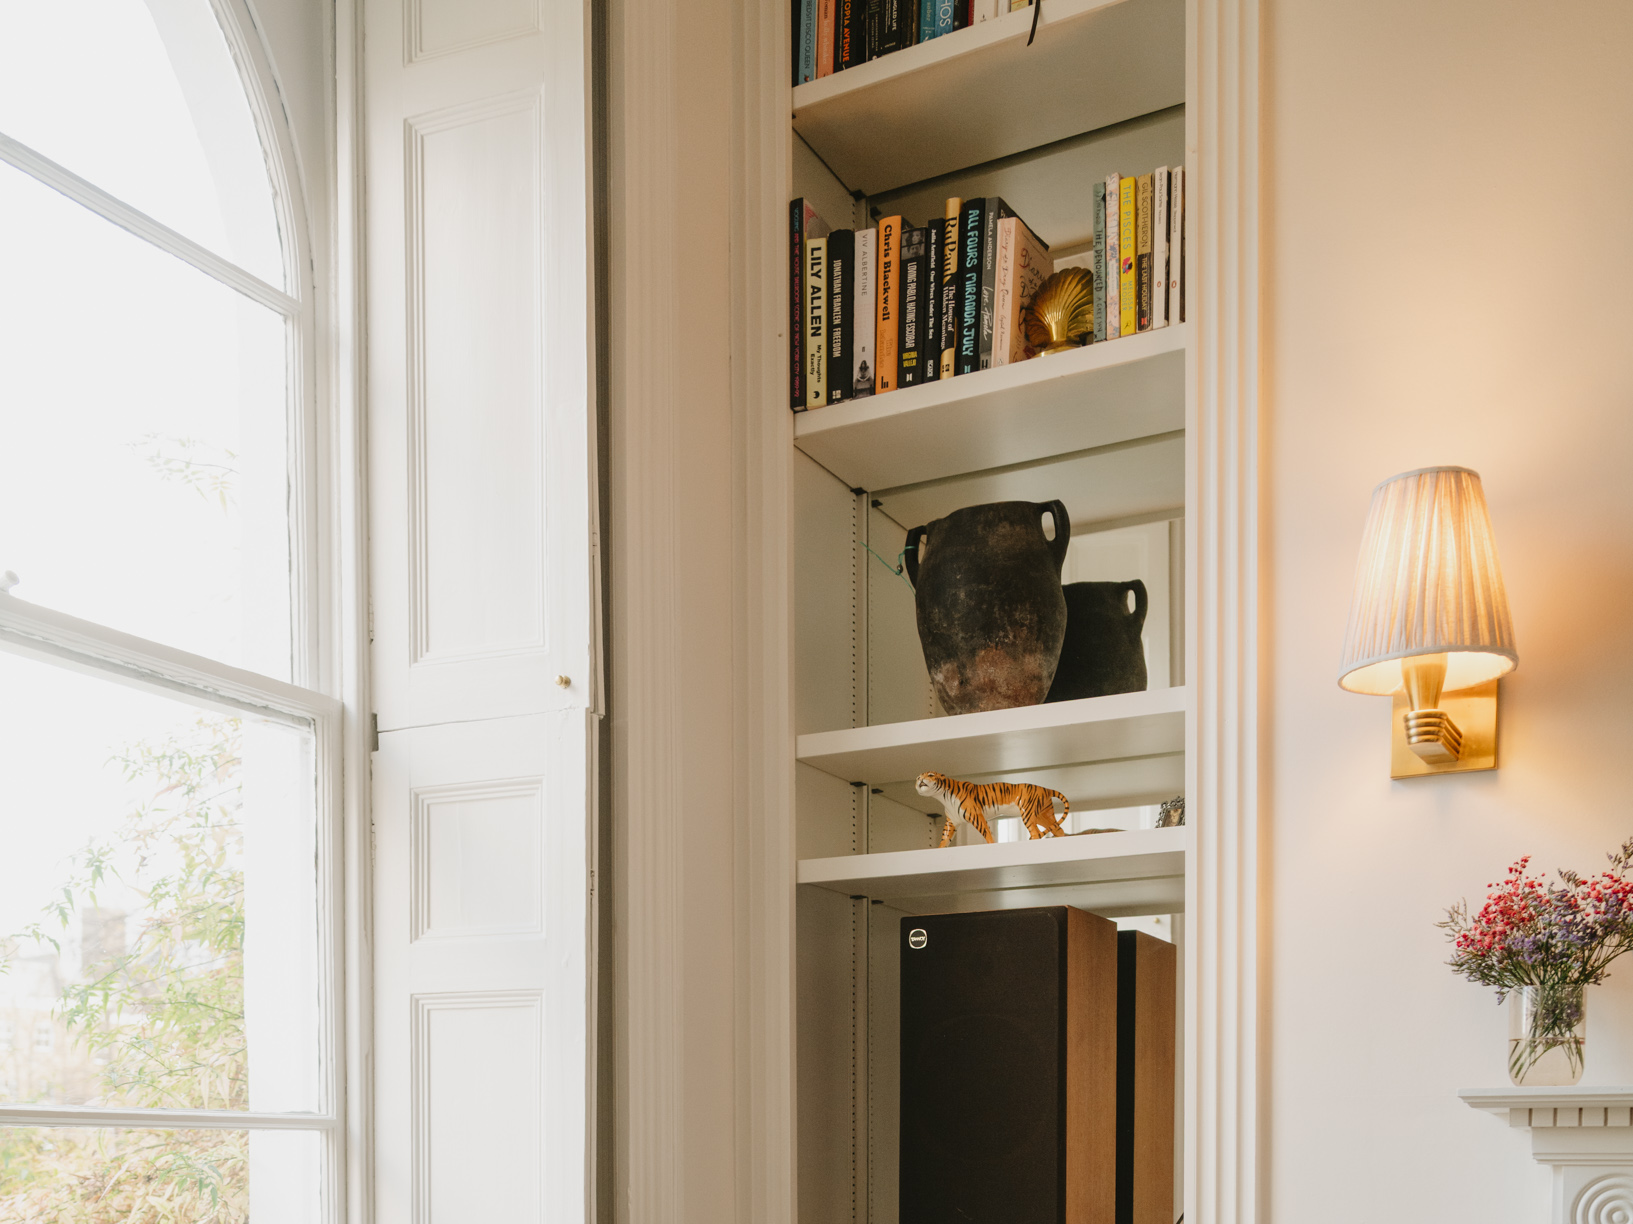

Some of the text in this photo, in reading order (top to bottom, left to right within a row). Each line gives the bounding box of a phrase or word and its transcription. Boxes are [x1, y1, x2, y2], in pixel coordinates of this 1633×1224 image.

[842, 28, 850, 62] AVENUE
[1123, 185, 1131, 250] THE PISCES
[965, 210, 980, 267] ALL FOURS
[882, 224, 892, 321] Chris Blackwell
[907, 262, 917, 282] LOVING
[1094, 229, 1103, 292] THE DENOUNCED
[811, 247, 821, 337] LILY ALLEN
[832, 260, 842, 324] JONATHAN FRANZEN
[906, 302, 916, 322] HATING
[947, 300, 955, 323] House
[947, 324, 954, 332] of
[961, 273, 976, 356] MIRANDA JULY
[815, 344, 822, 354] My
[832, 328, 841, 358] FREEDOM
[905, 323, 915, 349] ESCOBAR
